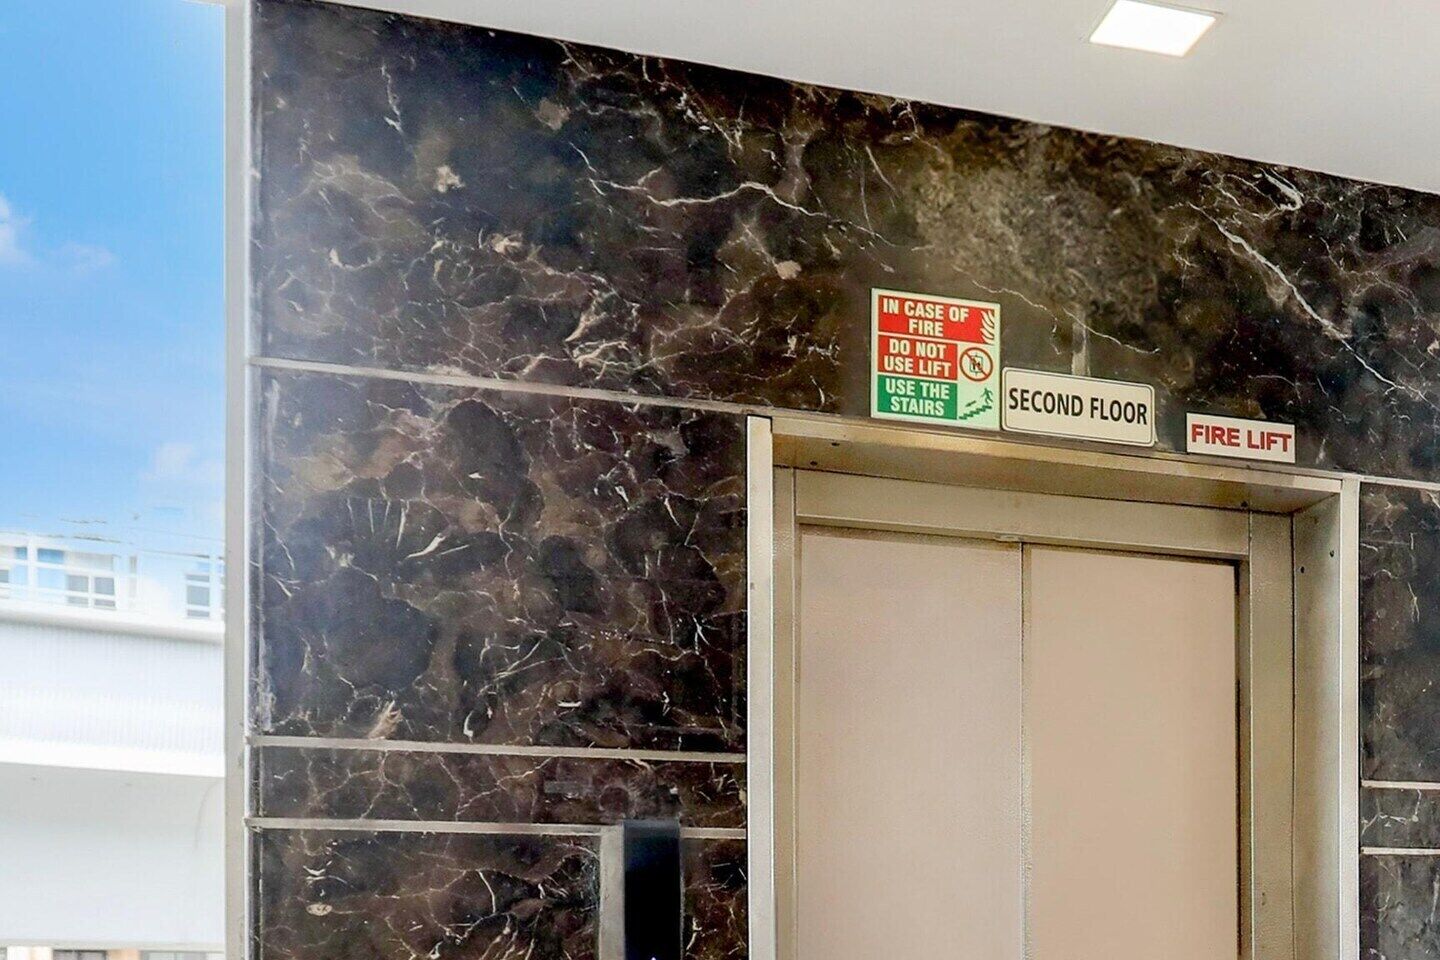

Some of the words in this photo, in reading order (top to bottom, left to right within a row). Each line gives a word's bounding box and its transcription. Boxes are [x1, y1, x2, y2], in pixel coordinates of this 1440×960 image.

[883, 298, 899, 315] IN
[904, 301, 944, 320] CASE
[949, 306, 969, 323] OF
[908, 319, 944, 337] FIRE
[889, 339, 910, 355] DO
[916, 341, 946, 359] NOT
[884, 355, 914, 374] USE
[919, 359, 951, 377] LIFT
[885, 378, 916, 396] USE
[920, 382, 950, 400] THE
[890, 396, 944, 416] STAIRS
[1008, 387, 1083, 417] SECOND
[1090, 397, 1148, 425] FLOOR
[1191, 423, 1241, 447] FIRE
[1247, 430, 1292, 452] LIFT
